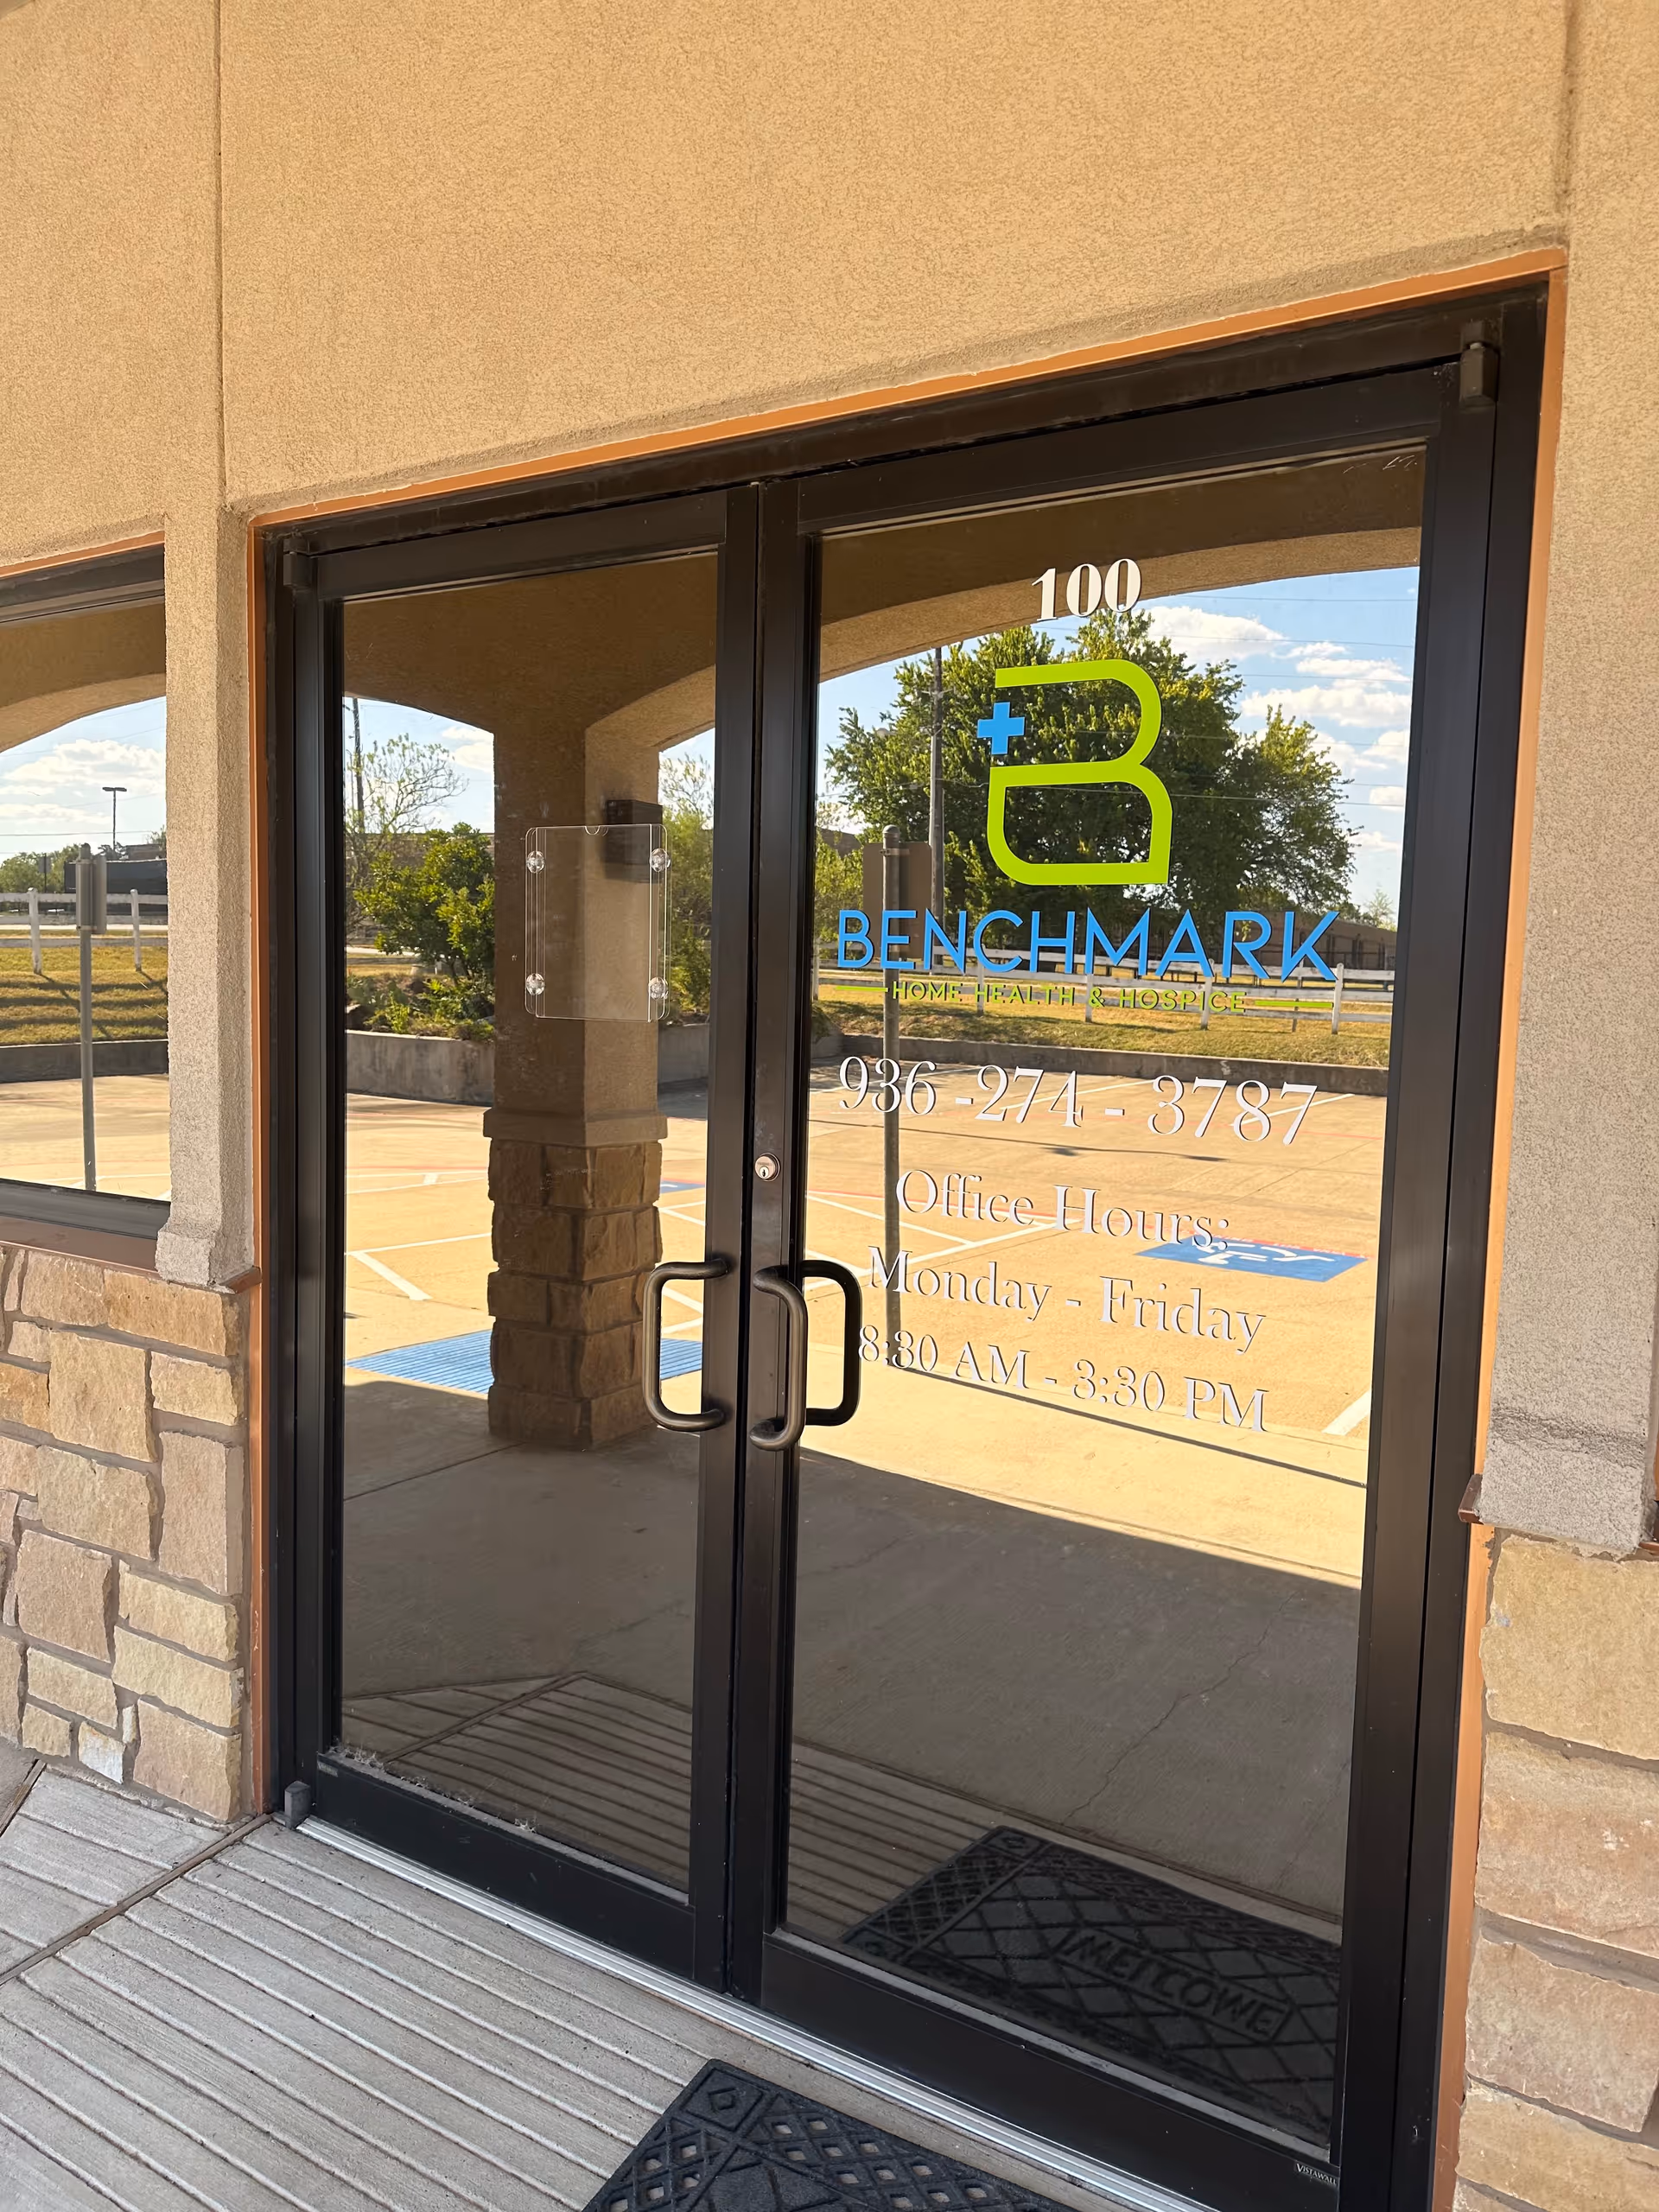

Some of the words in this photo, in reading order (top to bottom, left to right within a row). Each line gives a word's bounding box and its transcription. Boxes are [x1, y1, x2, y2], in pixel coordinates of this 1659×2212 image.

[1032, 558, 1141, 622] 100
[837, 907, 1339, 982] BENCHMARK
[892, 981, 963, 1002] HOME
[975, 983, 1075, 1007] HEALTH
[1088, 987, 1105, 1007] &
[1119, 988, 1247, 1013] HOSPICE
[839, 1056, 938, 1116] 936
[1147, 1075, 1318, 1146] 3787
[895, 1169, 1034, 1226] Office
[1052, 1185, 1230, 1251] Hours:
[868, 1246, 1052, 1322] Monday
[1099, 1276, 1266, 1356] Friday
[858, 1325, 938, 1372] 8:30
[953, 1341, 1031, 1389] AM
[1072, 1359, 1165, 1411] 3:30
[1183, 1376, 1269, 1432] PM
